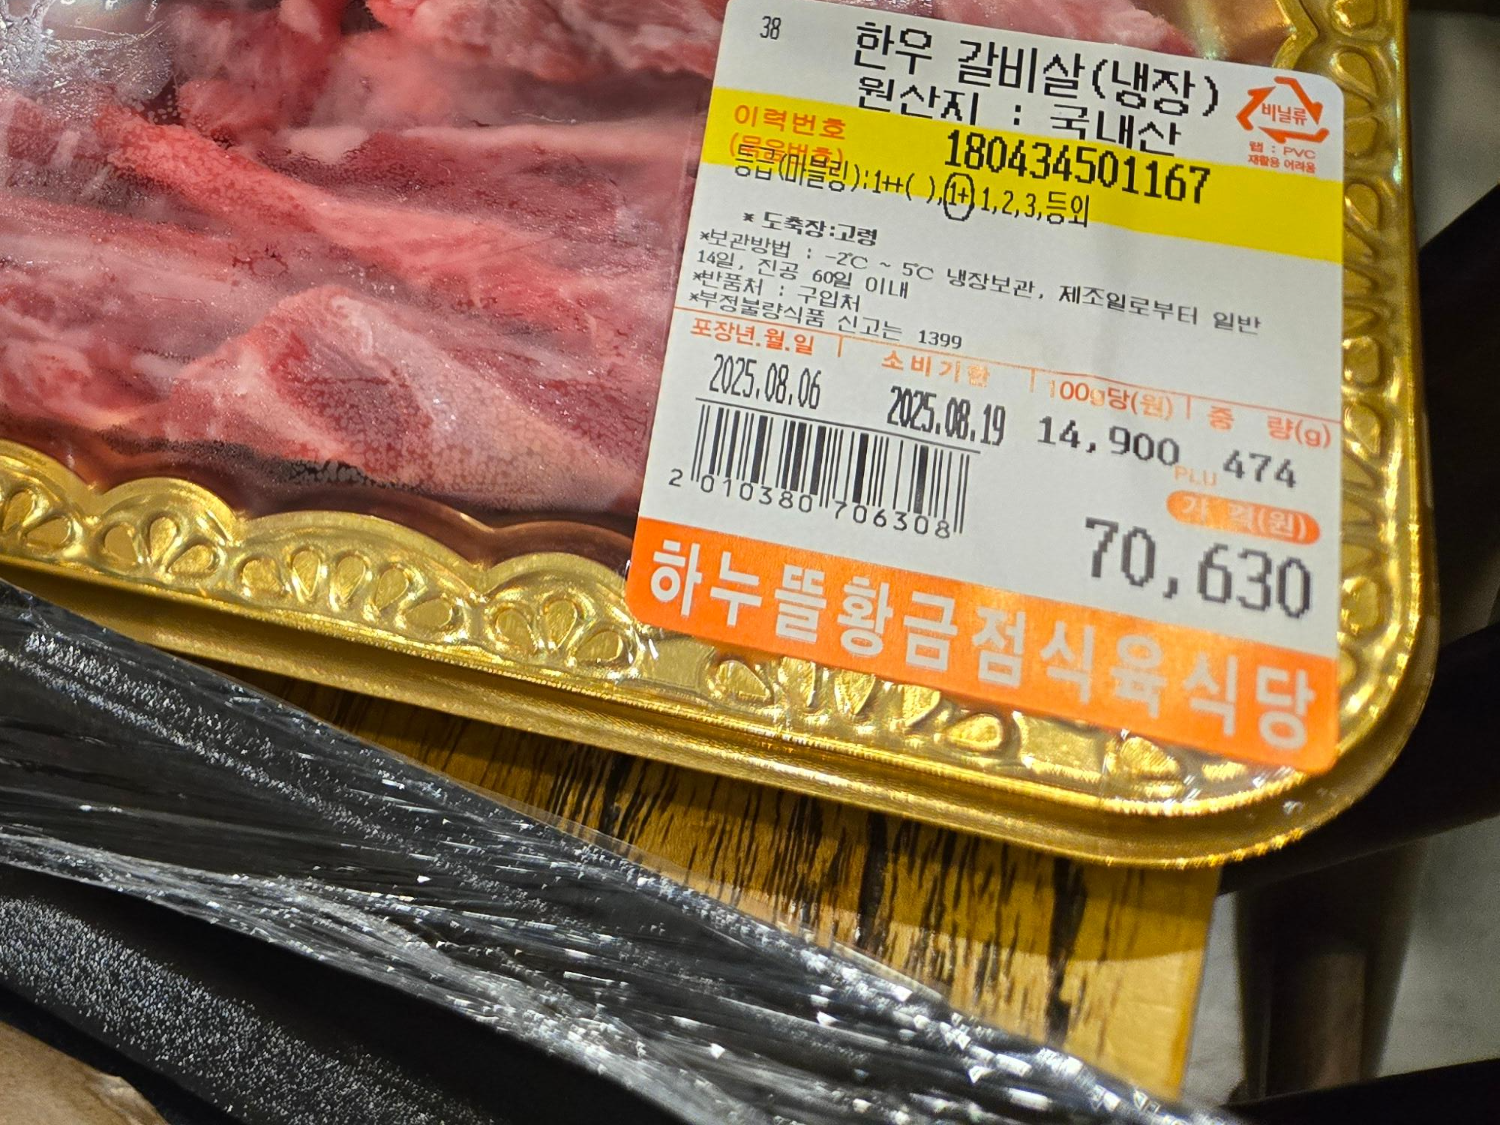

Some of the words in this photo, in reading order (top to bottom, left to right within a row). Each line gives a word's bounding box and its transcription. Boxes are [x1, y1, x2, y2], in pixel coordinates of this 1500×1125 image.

[760, 16, 782, 40] 38
[854, 22, 932, 75] 한우
[958, 40, 1219, 117] 갈비살(냉장)
[734, 104, 846, 140] 이력번호
[858, 76, 979, 126] 원산지
[1051, 103, 1181, 157] 국내산
[1261, 103, 1307, 126] 비닐류
[945, 129, 1211, 205] 180434501167
[1248, 154, 1280, 169] 재활용
[1283, 158, 1316, 174] 어려움
[1283, 146, 1316, 160] PVC
[697, 249, 744, 271] 14일,
[758, 258, 799, 281] 진공
[812, 269, 852, 290] 60일
[865, 276, 909, 299] 이내
[798, 285, 861, 313] 구입처
[947, 268, 1044, 300] 냉장보관,
[1059, 284, 1198, 326] 제조일로부터
[1213, 311, 1261, 336] 일반
[838, 314, 903, 342] 신고는
[918, 329, 963, 350] 1399
[690, 317, 815, 356] 포장년.월.일
[1050, 379, 1174, 421] 100g당(원)
[709, 353, 822, 410] 2025.08.06
[886, 385, 1006, 446] 2025.08.19
[1037, 415, 1180, 467] 14,900
[1222, 449, 1297, 489] 474
[1173, 464, 1218, 486] PLU
[1085, 516, 1312, 619] 70,630
[649, 538, 1315, 752] 하누뜰황금점식육식당
